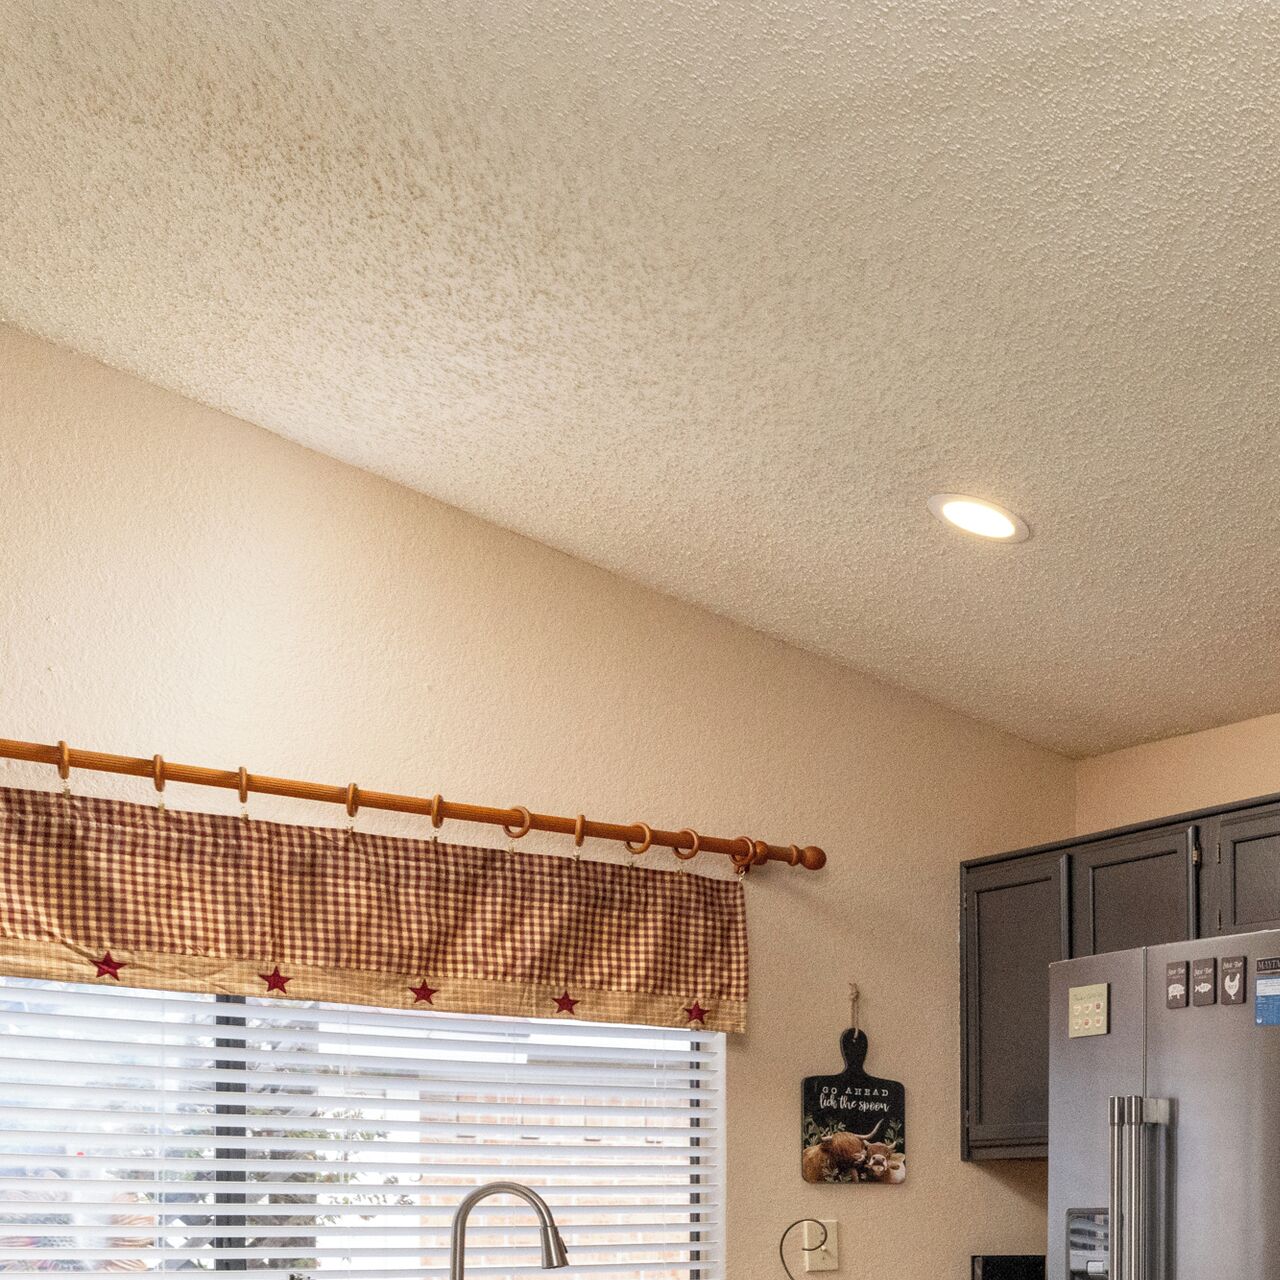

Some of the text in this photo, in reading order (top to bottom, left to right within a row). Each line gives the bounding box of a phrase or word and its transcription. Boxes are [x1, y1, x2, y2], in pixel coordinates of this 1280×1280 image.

[822, 1086, 889, 1097] GO AHEAD
[820, 1093, 891, 1112] lick the spoon
